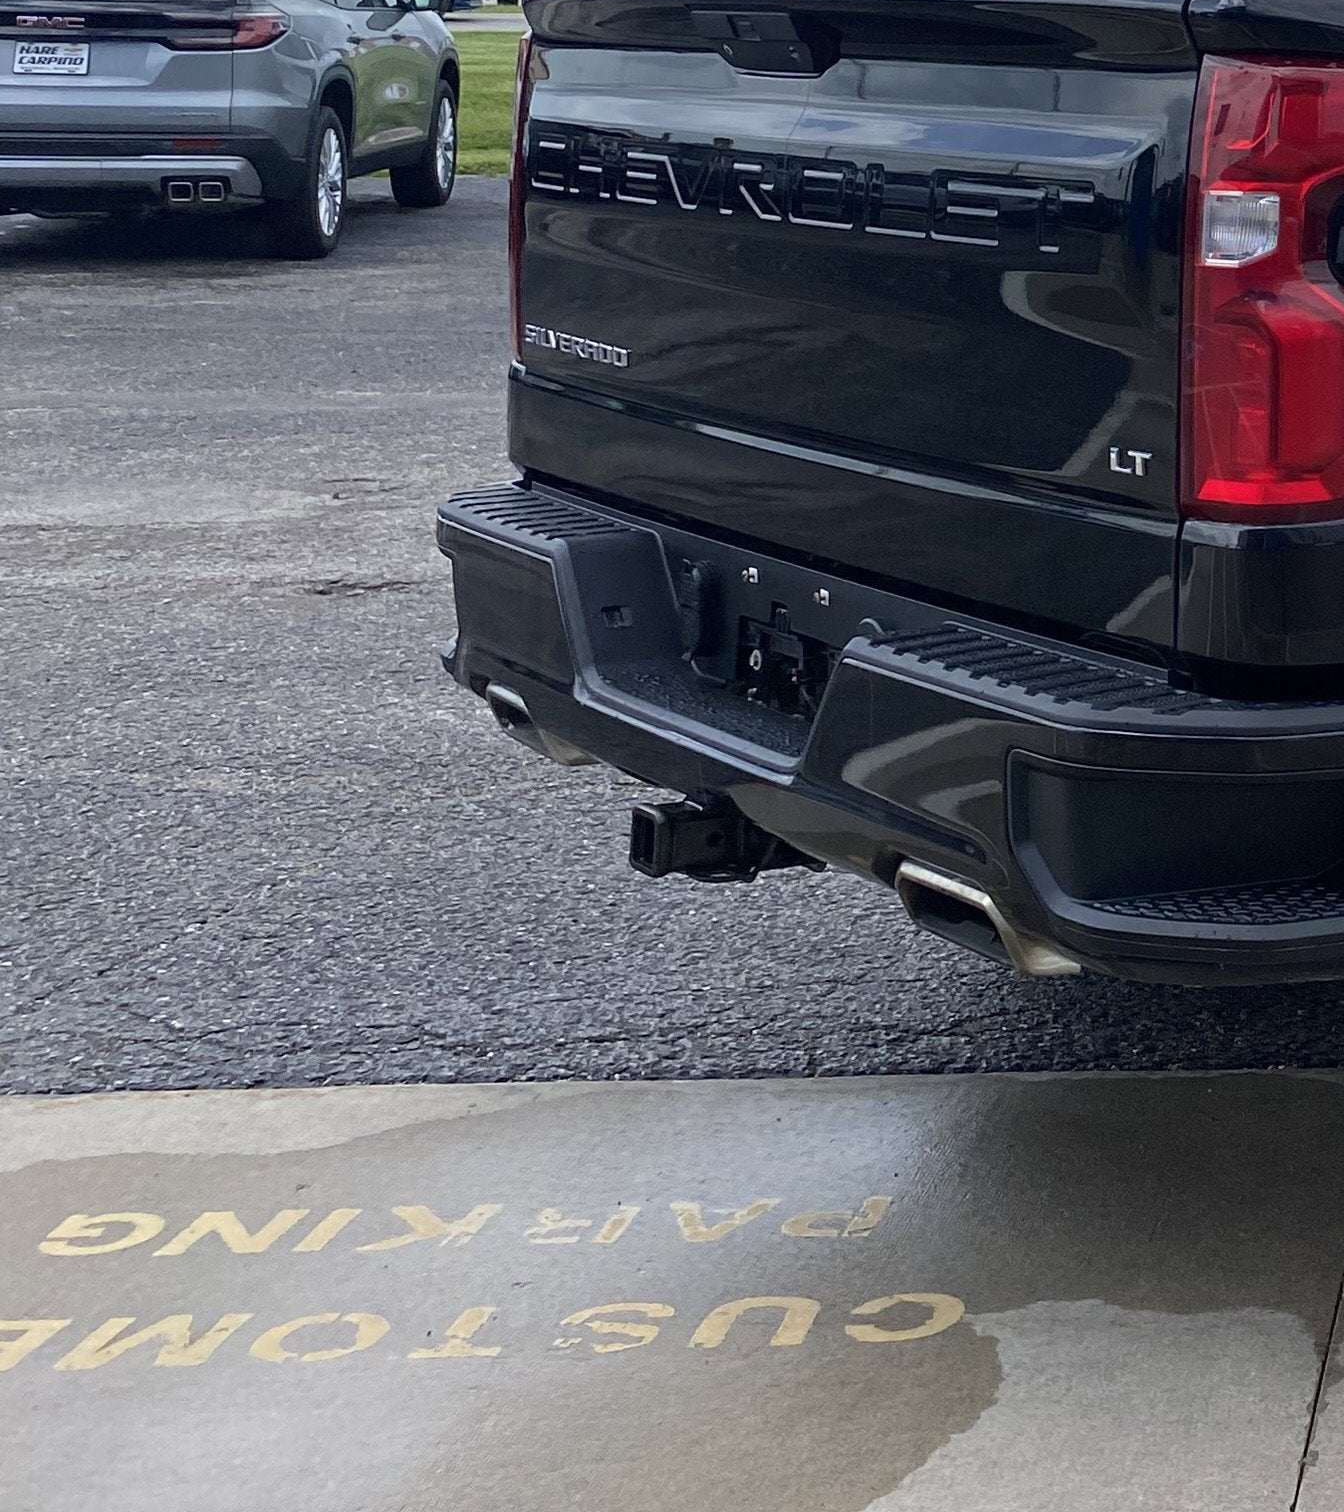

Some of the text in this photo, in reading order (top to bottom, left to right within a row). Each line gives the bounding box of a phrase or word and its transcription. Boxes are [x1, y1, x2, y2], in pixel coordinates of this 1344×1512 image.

[16, 15, 86, 29] GMC
[18, 56, 84, 66] CARPINO
[19, 45, 59, 55] HARE
[530, 136, 1096, 255] CHEVROLET
[524, 324, 631, 368] SILVERADO
[1110, 447, 1152, 476] LT
[38, 1194, 893, 1256] PARKING
